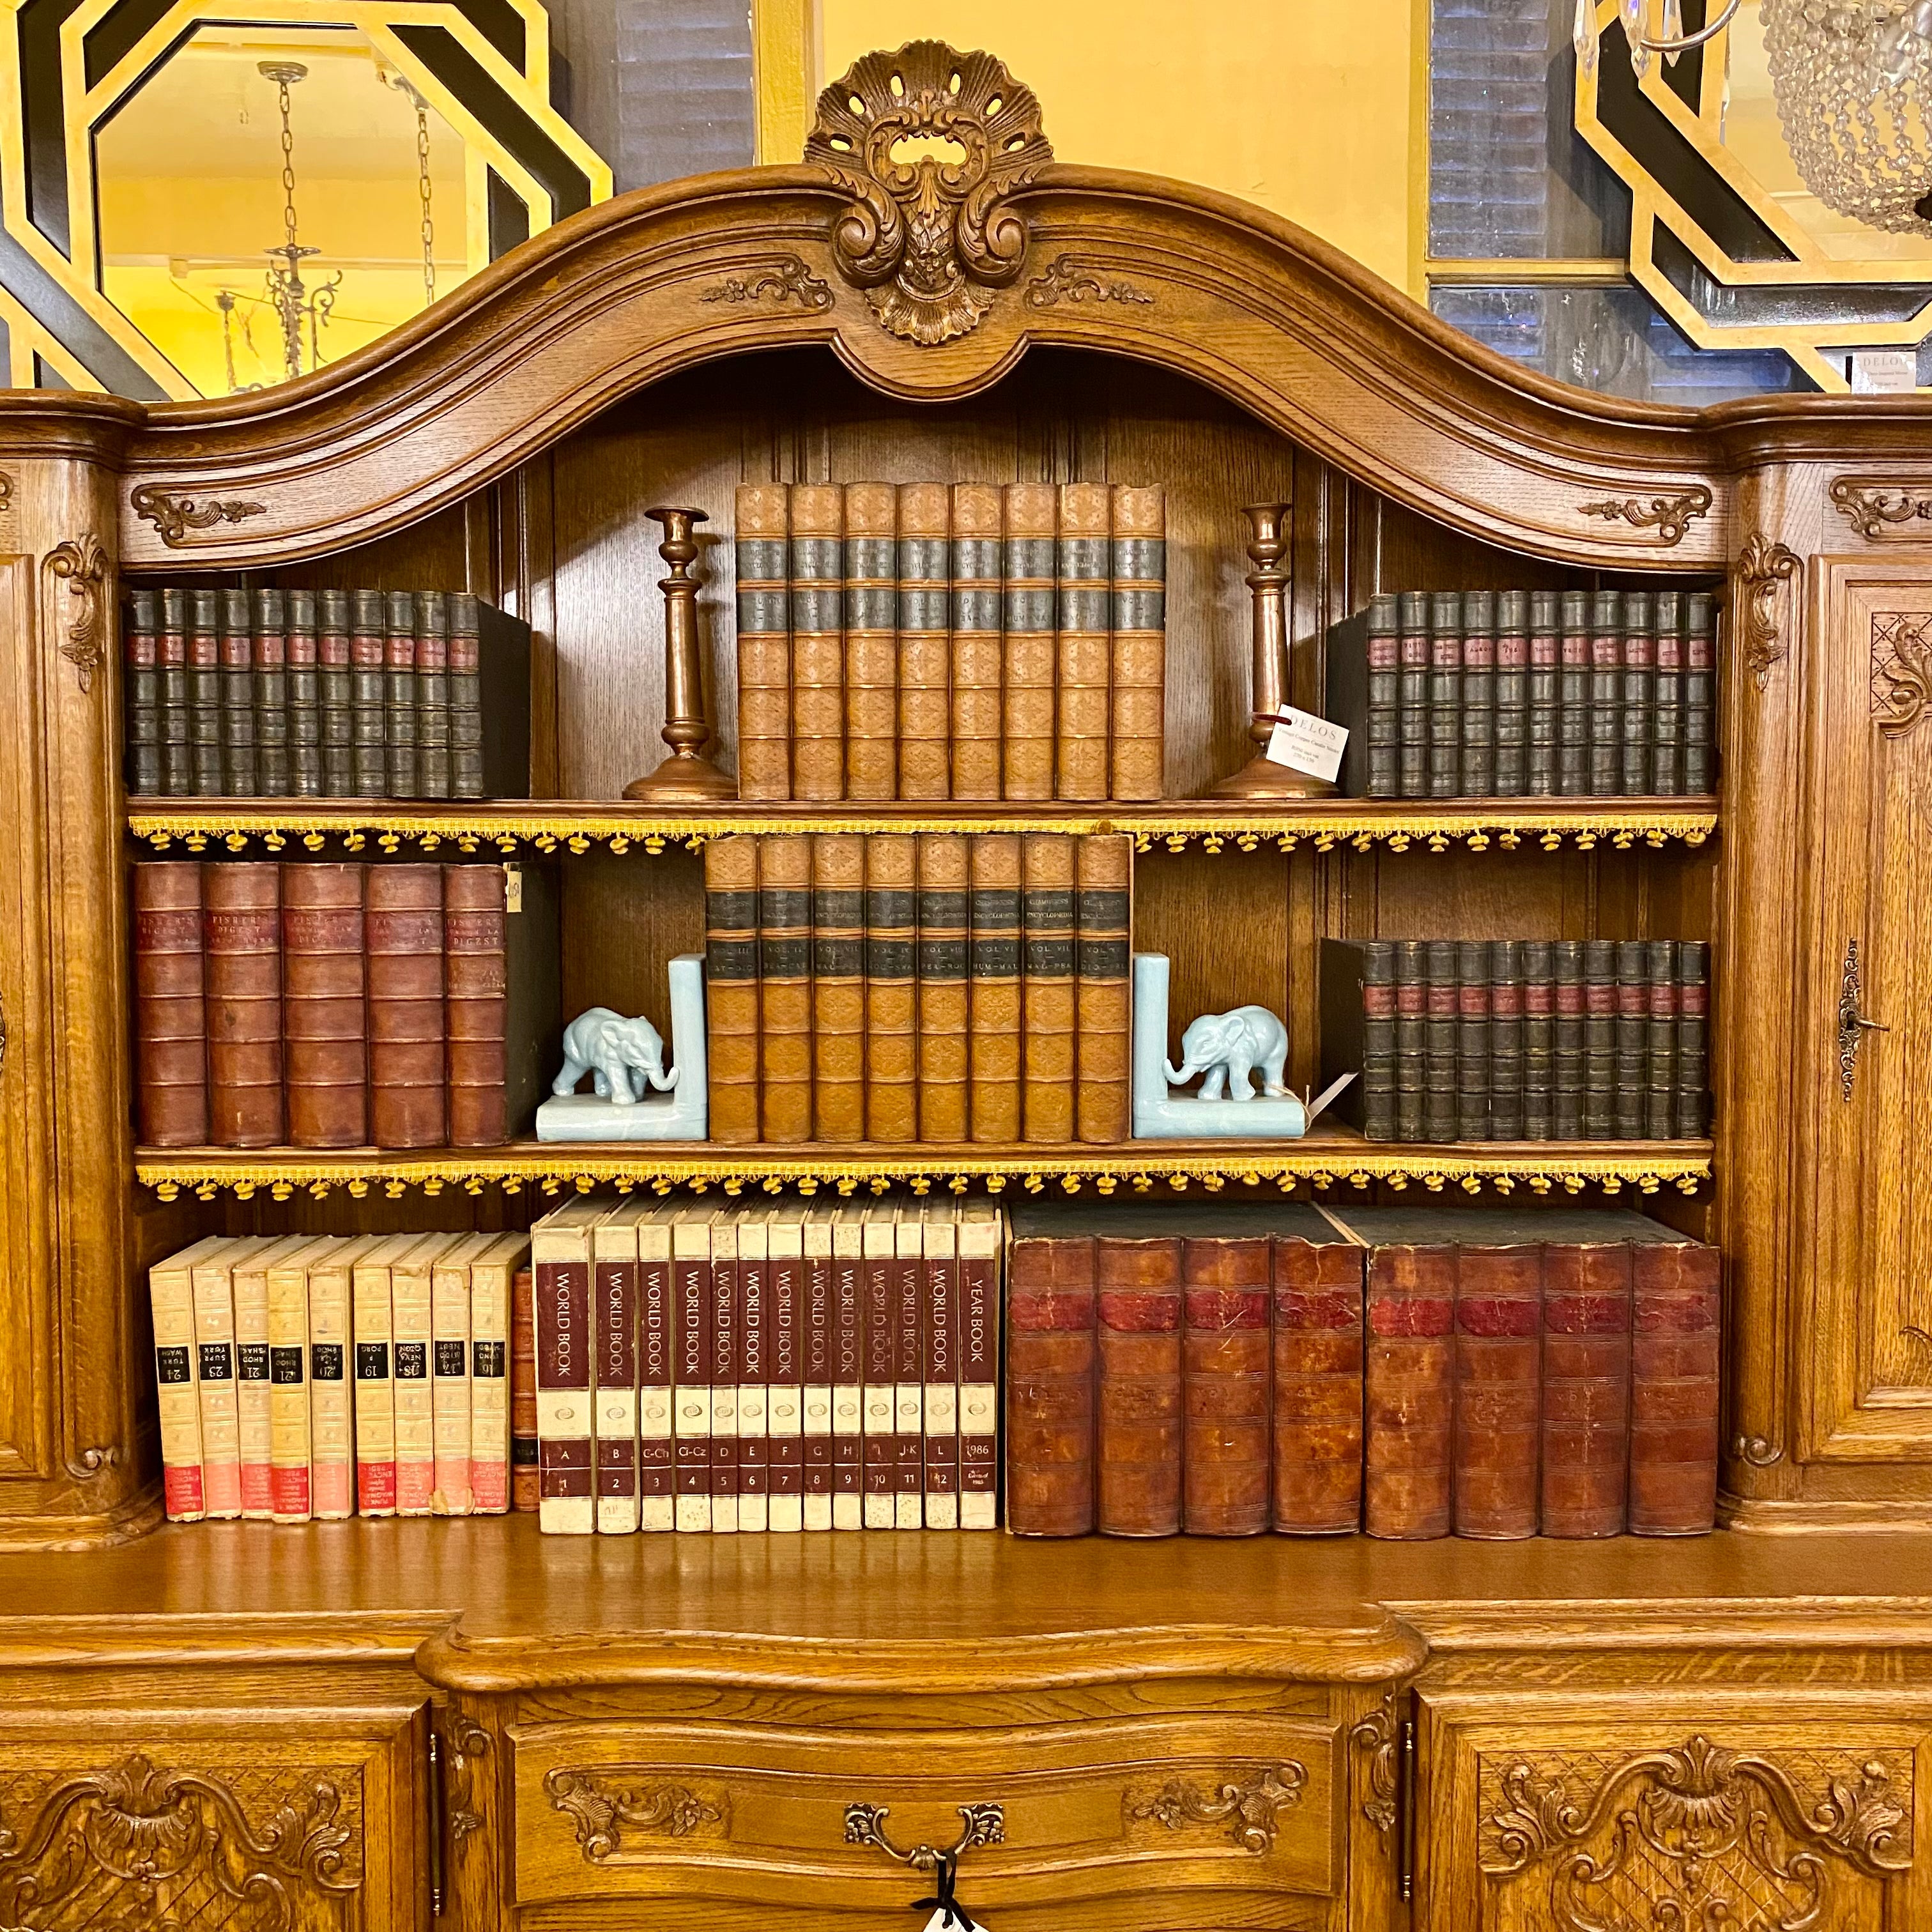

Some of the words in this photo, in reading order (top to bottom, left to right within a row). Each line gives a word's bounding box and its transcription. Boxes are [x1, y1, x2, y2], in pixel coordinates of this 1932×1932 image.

[1863, 356, 1902, 367] DELO
[556, 1272, 571, 1330] WORLD
[608, 1271, 623, 1329] WORLD
[647, 1271, 661, 1328] WORLD
[685, 1271, 700, 1328] WORLD
[716, 1270, 730, 1327] WORLD
[746, 1270, 760, 1327] WORLD
[777, 1269, 792, 1327] WORLD
[811, 1269, 825, 1326] WORLD
[840, 1269, 854, 1326] WORLD
[902, 1268, 916, 1326] WORLD
[932, 1268, 946, 1326] WORLD
[970, 1279, 984, 1315] YEAR
[970, 1318, 984, 1363] BOOK
[557, 1331, 571, 1377] BOOK
[609, 1332, 623, 1376] BOOK
[648, 1330, 662, 1376] BOOK
[686, 1330, 700, 1374] BOOK
[717, 1330, 731, 1374] BOOK
[746, 1329, 761, 1374] BOOK
[778, 1330, 792, 1374] BOOK
[811, 1329, 825, 1373] BOOK
[840, 1328, 855, 1373] BOOK
[902, 1328, 916, 1372] BOOK
[933, 1328, 947, 1373] BOOK
[208, 1365, 224, 1377] 23
[246, 1366, 260, 1378] 21
[279, 1370, 291, 1382] 21
[365, 1365, 377, 1377] 19
[560, 1449, 570, 1460] A
[613, 1449, 620, 1459] B
[643, 1447, 670, 1459] C-Ch
[678, 1446, 707, 1457] Ci-Cz
[719, 1447, 728, 1457] D
[749, 1446, 755, 1456] E
[781, 1446, 788, 1456] F
[813, 1446, 822, 1456] G
[844, 1445, 852, 1455] H
[937, 1445, 944, 1455] L
[966, 1444, 989, 1457] 1986
[613, 1478, 620, 1489] 2
[653, 1477, 659, 1487] 3
[688, 1476, 696, 1486] 4
[720, 1476, 727, 1486] 5
[748, 1475, 756, 1486] 6
[781, 1476, 788, 1486] 7
[813, 1475, 820, 1485] 8
[845, 1474, 852, 1484] 9
[875, 1474, 886, 1485] 10
[904, 1474, 915, 1484] 11
[935, 1473, 947, 1485] 12
